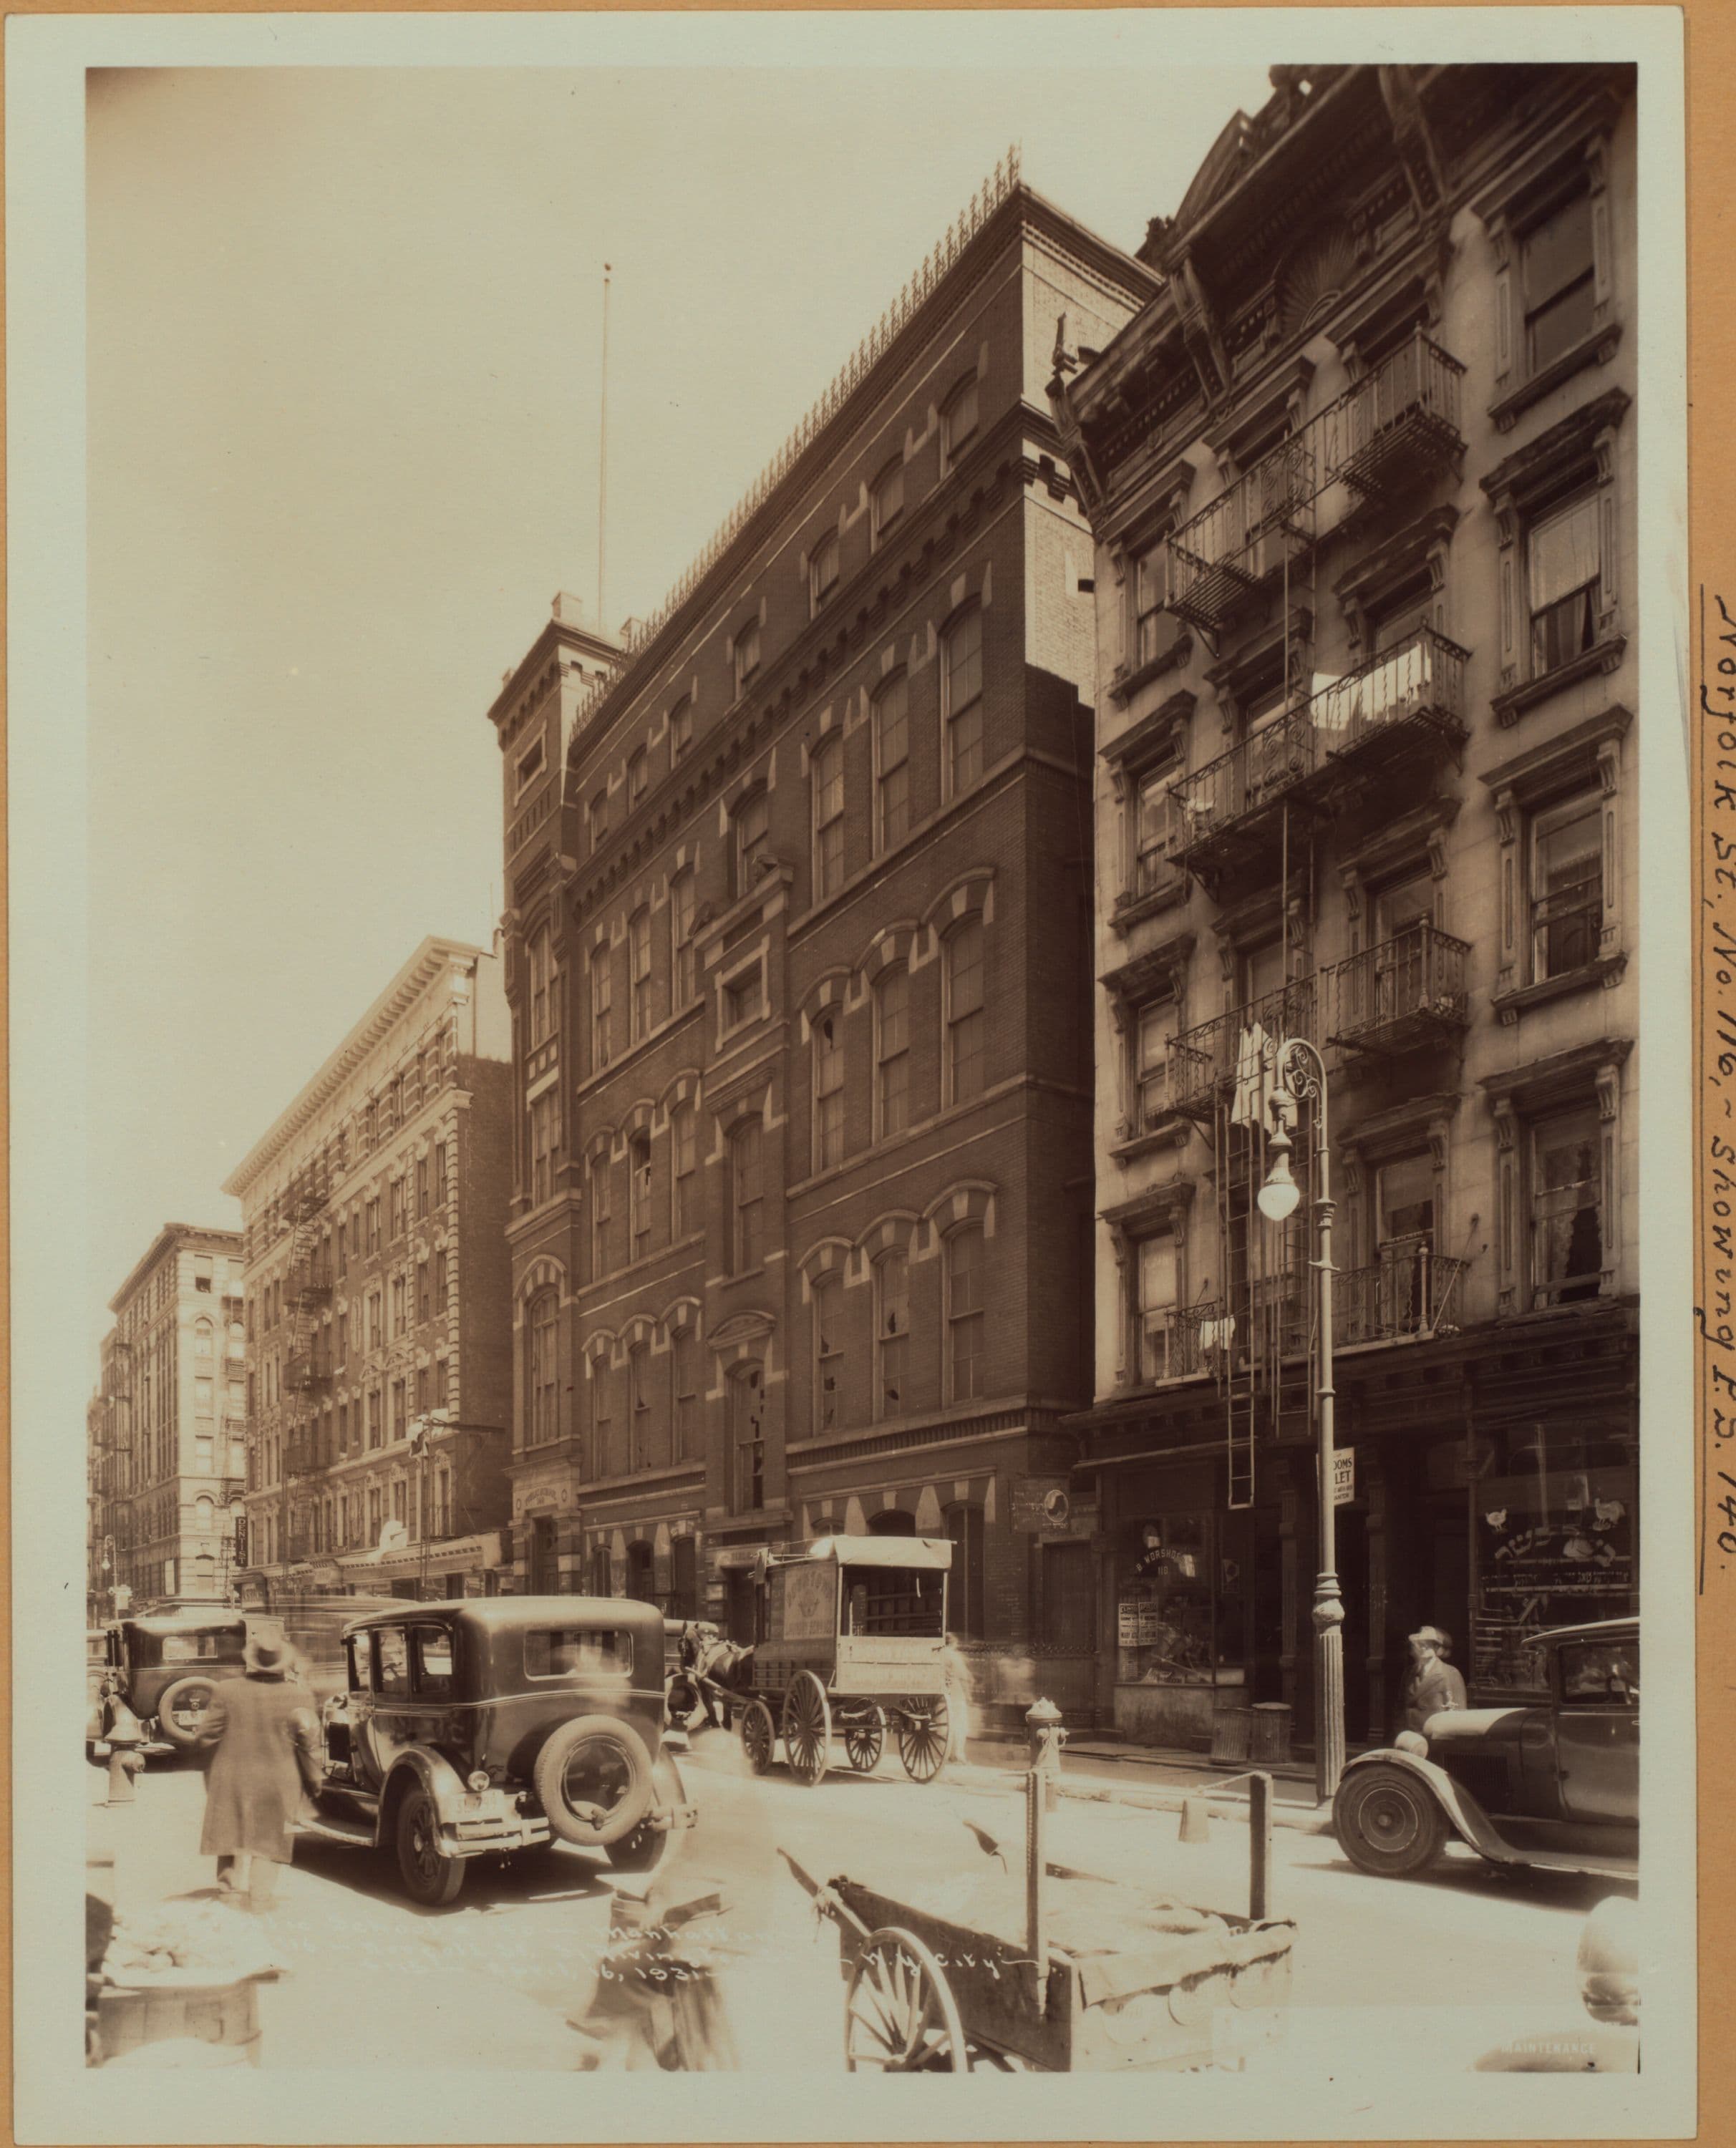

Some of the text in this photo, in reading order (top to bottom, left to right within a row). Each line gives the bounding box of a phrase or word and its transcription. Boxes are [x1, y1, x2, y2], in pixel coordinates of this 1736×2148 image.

[1333, 1457, 1352, 1471] OOMS
[1335, 1470, 1351, 1485] LET
[238, 1518, 246, 1565] DENTIST
